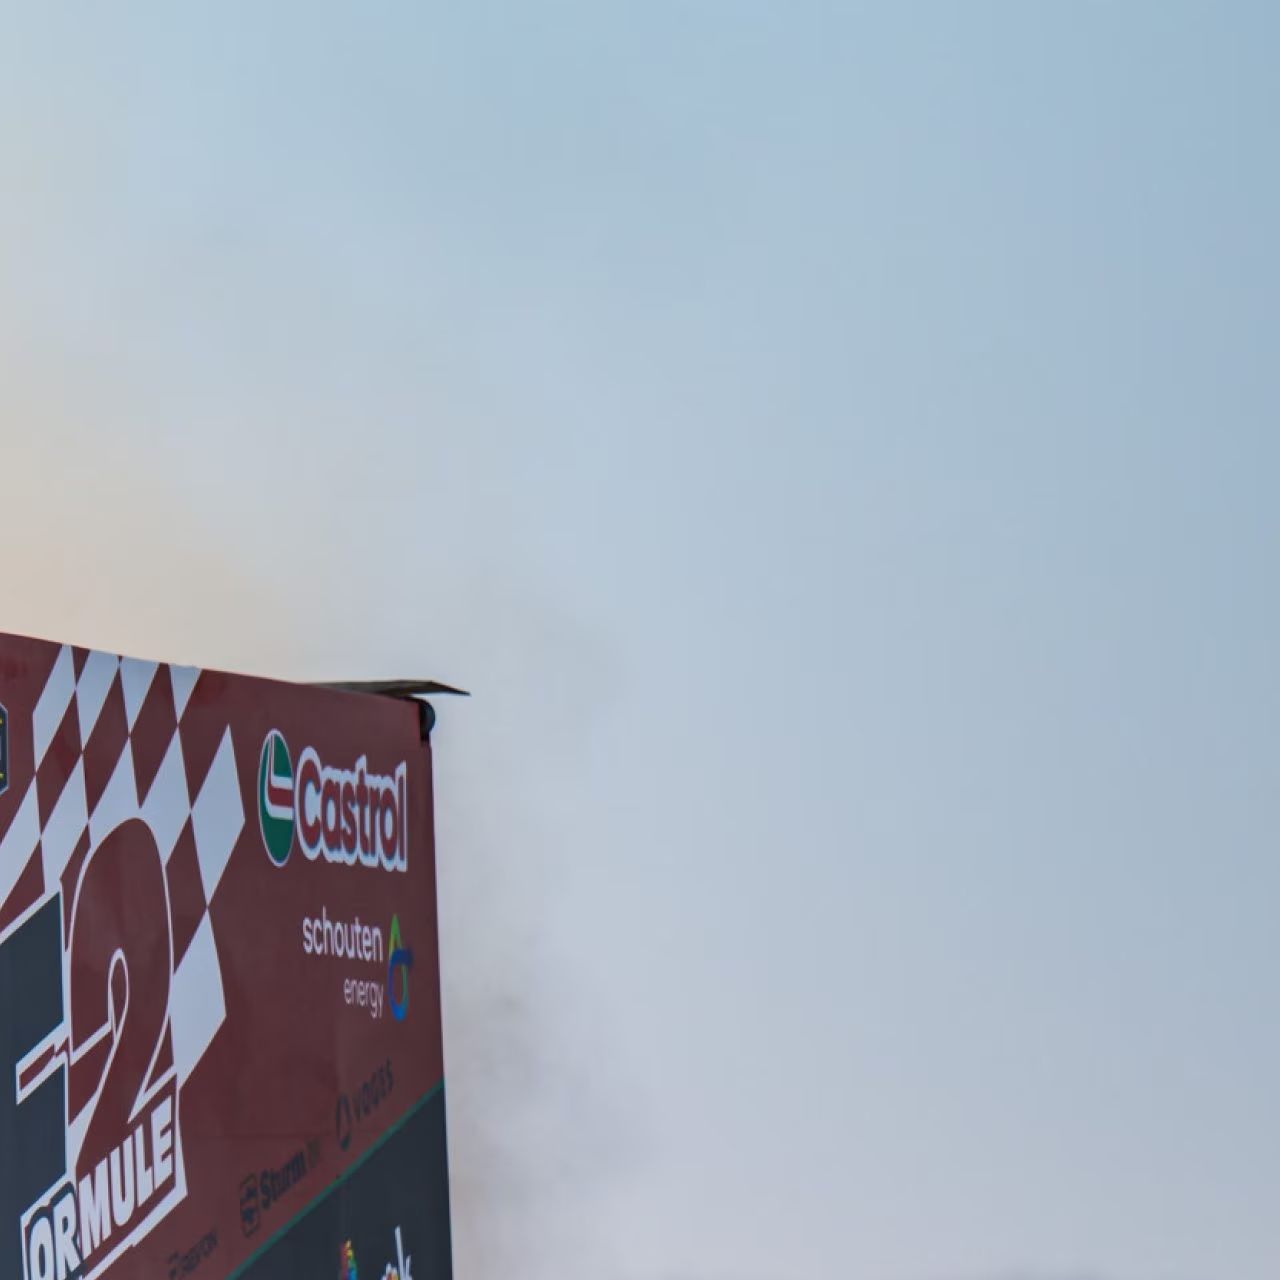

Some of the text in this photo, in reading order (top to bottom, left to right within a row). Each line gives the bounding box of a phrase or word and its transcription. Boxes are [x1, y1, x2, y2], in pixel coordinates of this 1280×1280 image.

[297, 746, 407, 872] Castrol
[303, 905, 383, 963] schouten
[343, 977, 384, 1019] energy
